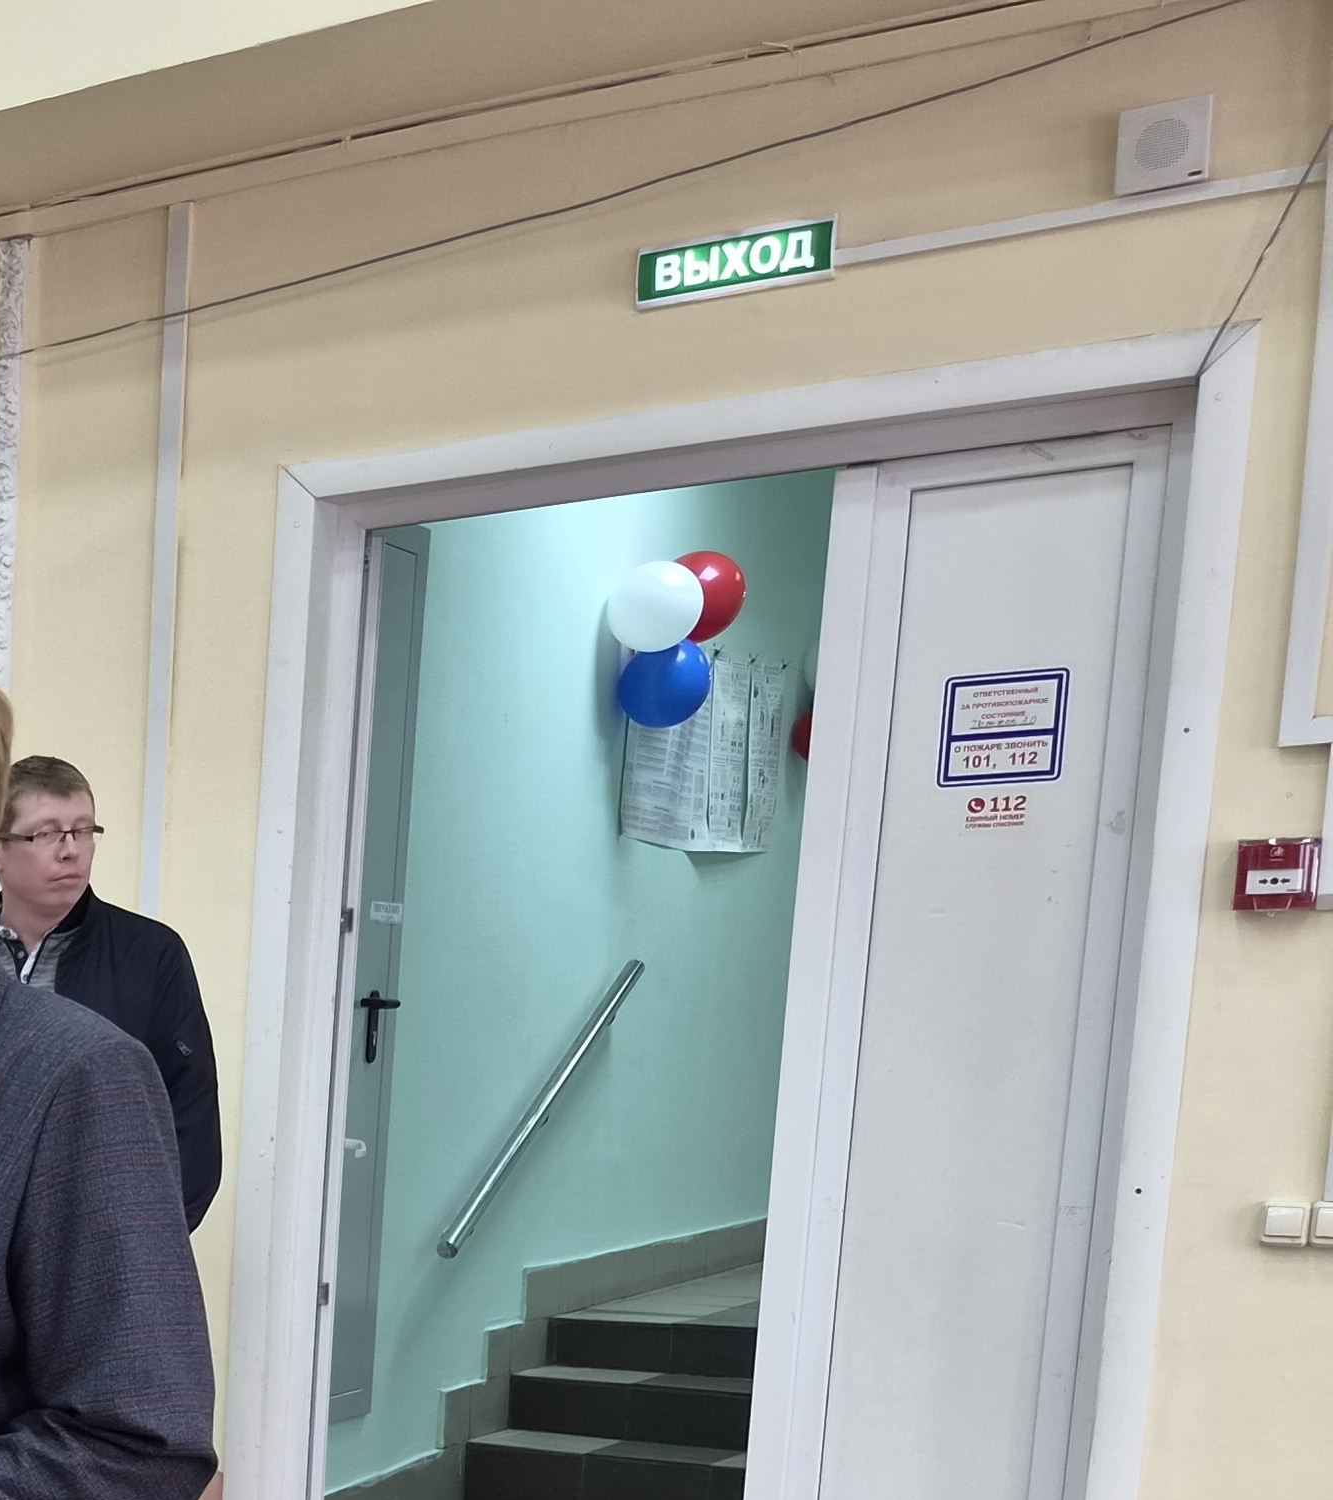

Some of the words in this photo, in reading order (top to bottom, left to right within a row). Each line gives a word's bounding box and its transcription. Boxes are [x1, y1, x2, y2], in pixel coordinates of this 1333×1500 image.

[654, 230, 815, 292] ВЫХОД
[973, 687, 1038, 698] ОТВЕТСТВЕННЫЙ
[960, 703, 971, 711] ЗА
[972, 698, 1050, 710] ПРОТИВОПОЖАРНОЕ
[981, 711, 1026, 720] СОСТОЯНИЕ
[954, 745, 961, 753] О
[963, 743, 1003, 753] ПОЖАРЕ
[1004, 740, 1049, 750] ЗВОНИТЬ
[962, 755, 997, 769] 101,
[1009, 751, 1039, 766] 112
[990, 795, 1027, 812] 112
[965, 814, 998, 822] ЕДИНЫЙ
[1000, 813, 1025, 821] НОМЕР
